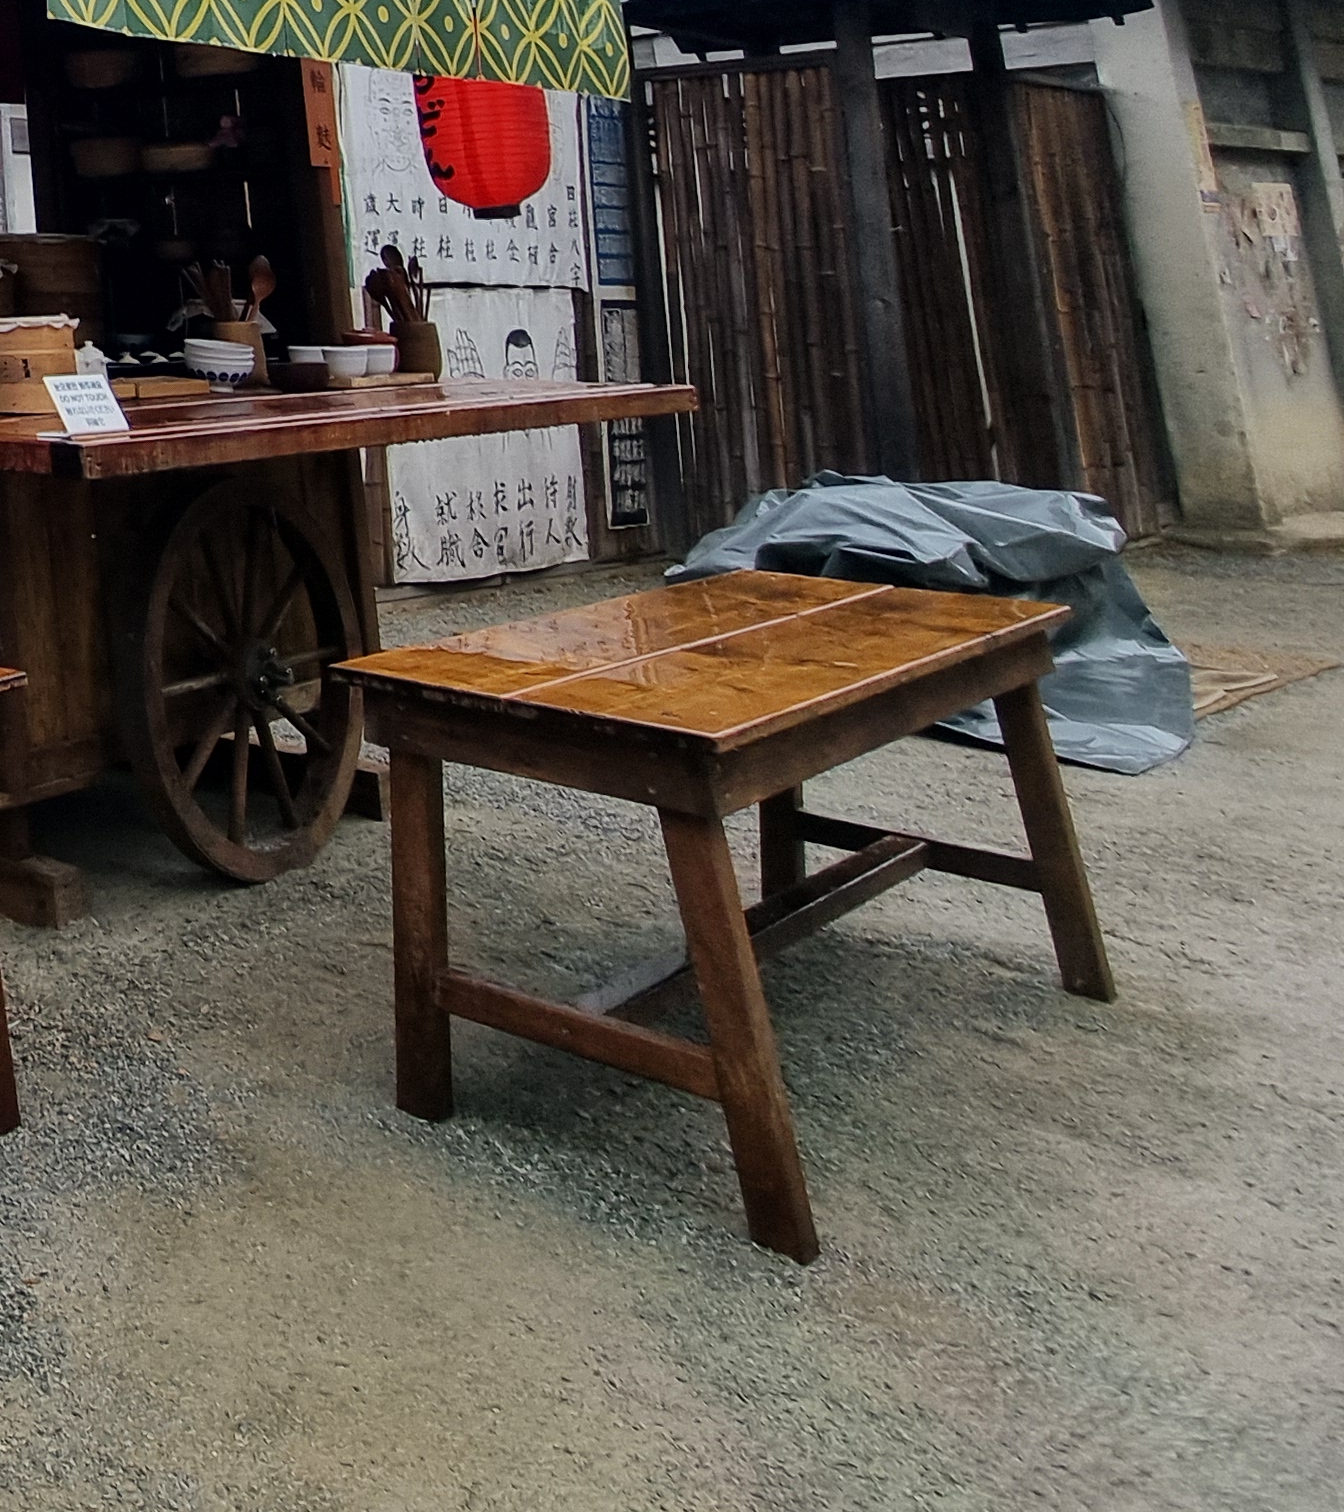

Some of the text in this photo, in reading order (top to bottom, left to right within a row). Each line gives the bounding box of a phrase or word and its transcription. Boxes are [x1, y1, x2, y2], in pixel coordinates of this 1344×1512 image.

[70, 394, 84, 403] NOT
[83, 392, 109, 402] TOUCH
[516, 477, 535, 563] 出行
